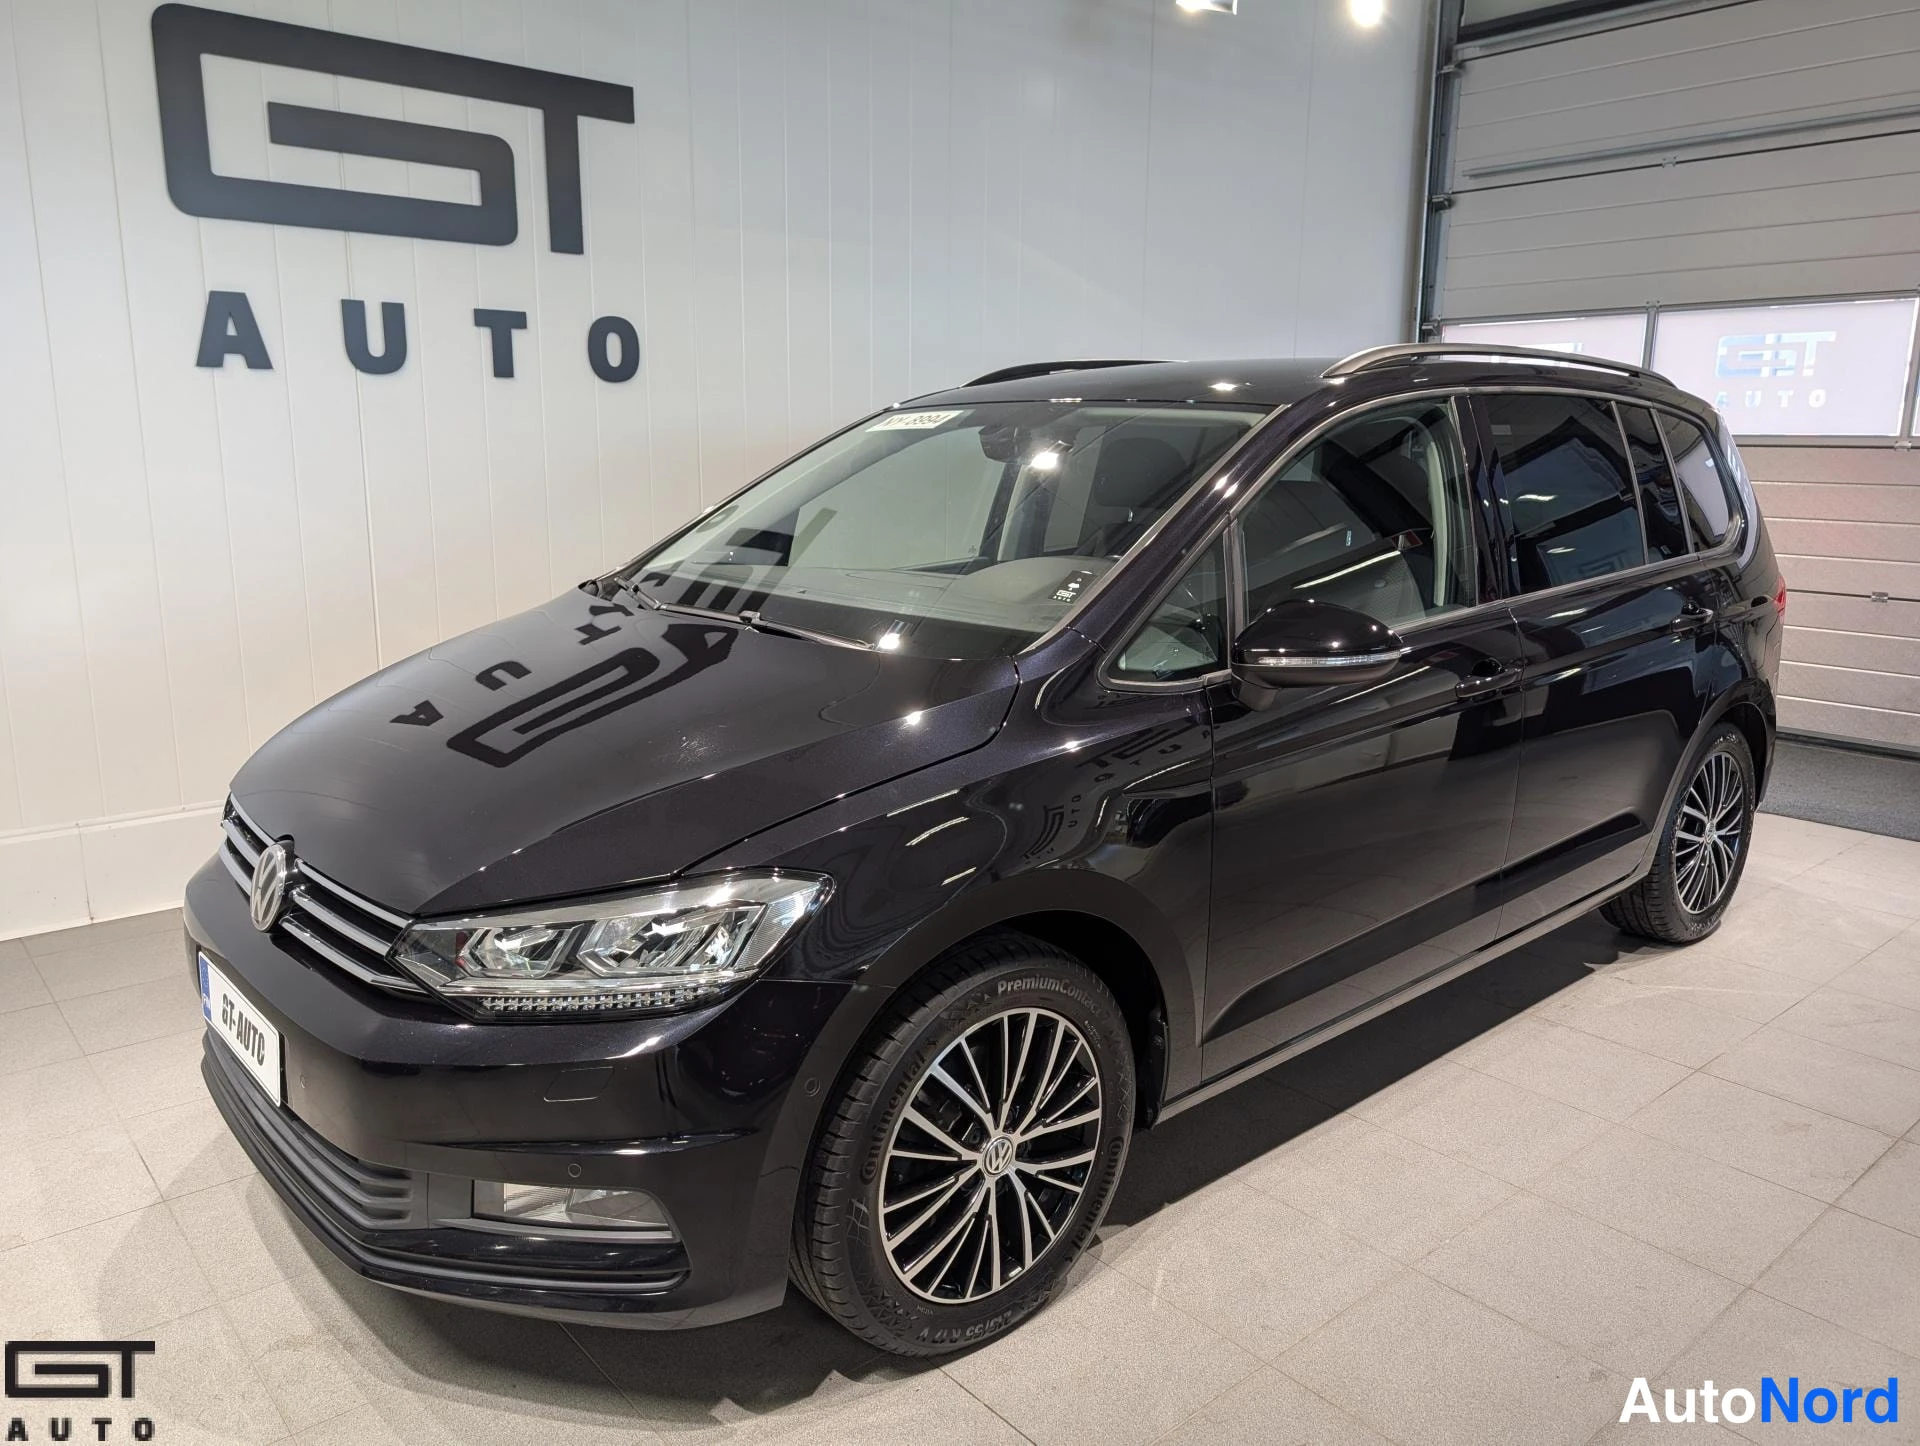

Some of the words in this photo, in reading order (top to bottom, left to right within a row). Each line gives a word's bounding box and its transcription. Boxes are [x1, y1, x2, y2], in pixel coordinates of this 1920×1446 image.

[151, 3, 635, 255] GT
[196, 290, 641, 384] AUTO
[1716, 389, 1826, 408] AUTO
[221, 992, 266, 1067] GT-AUTO
